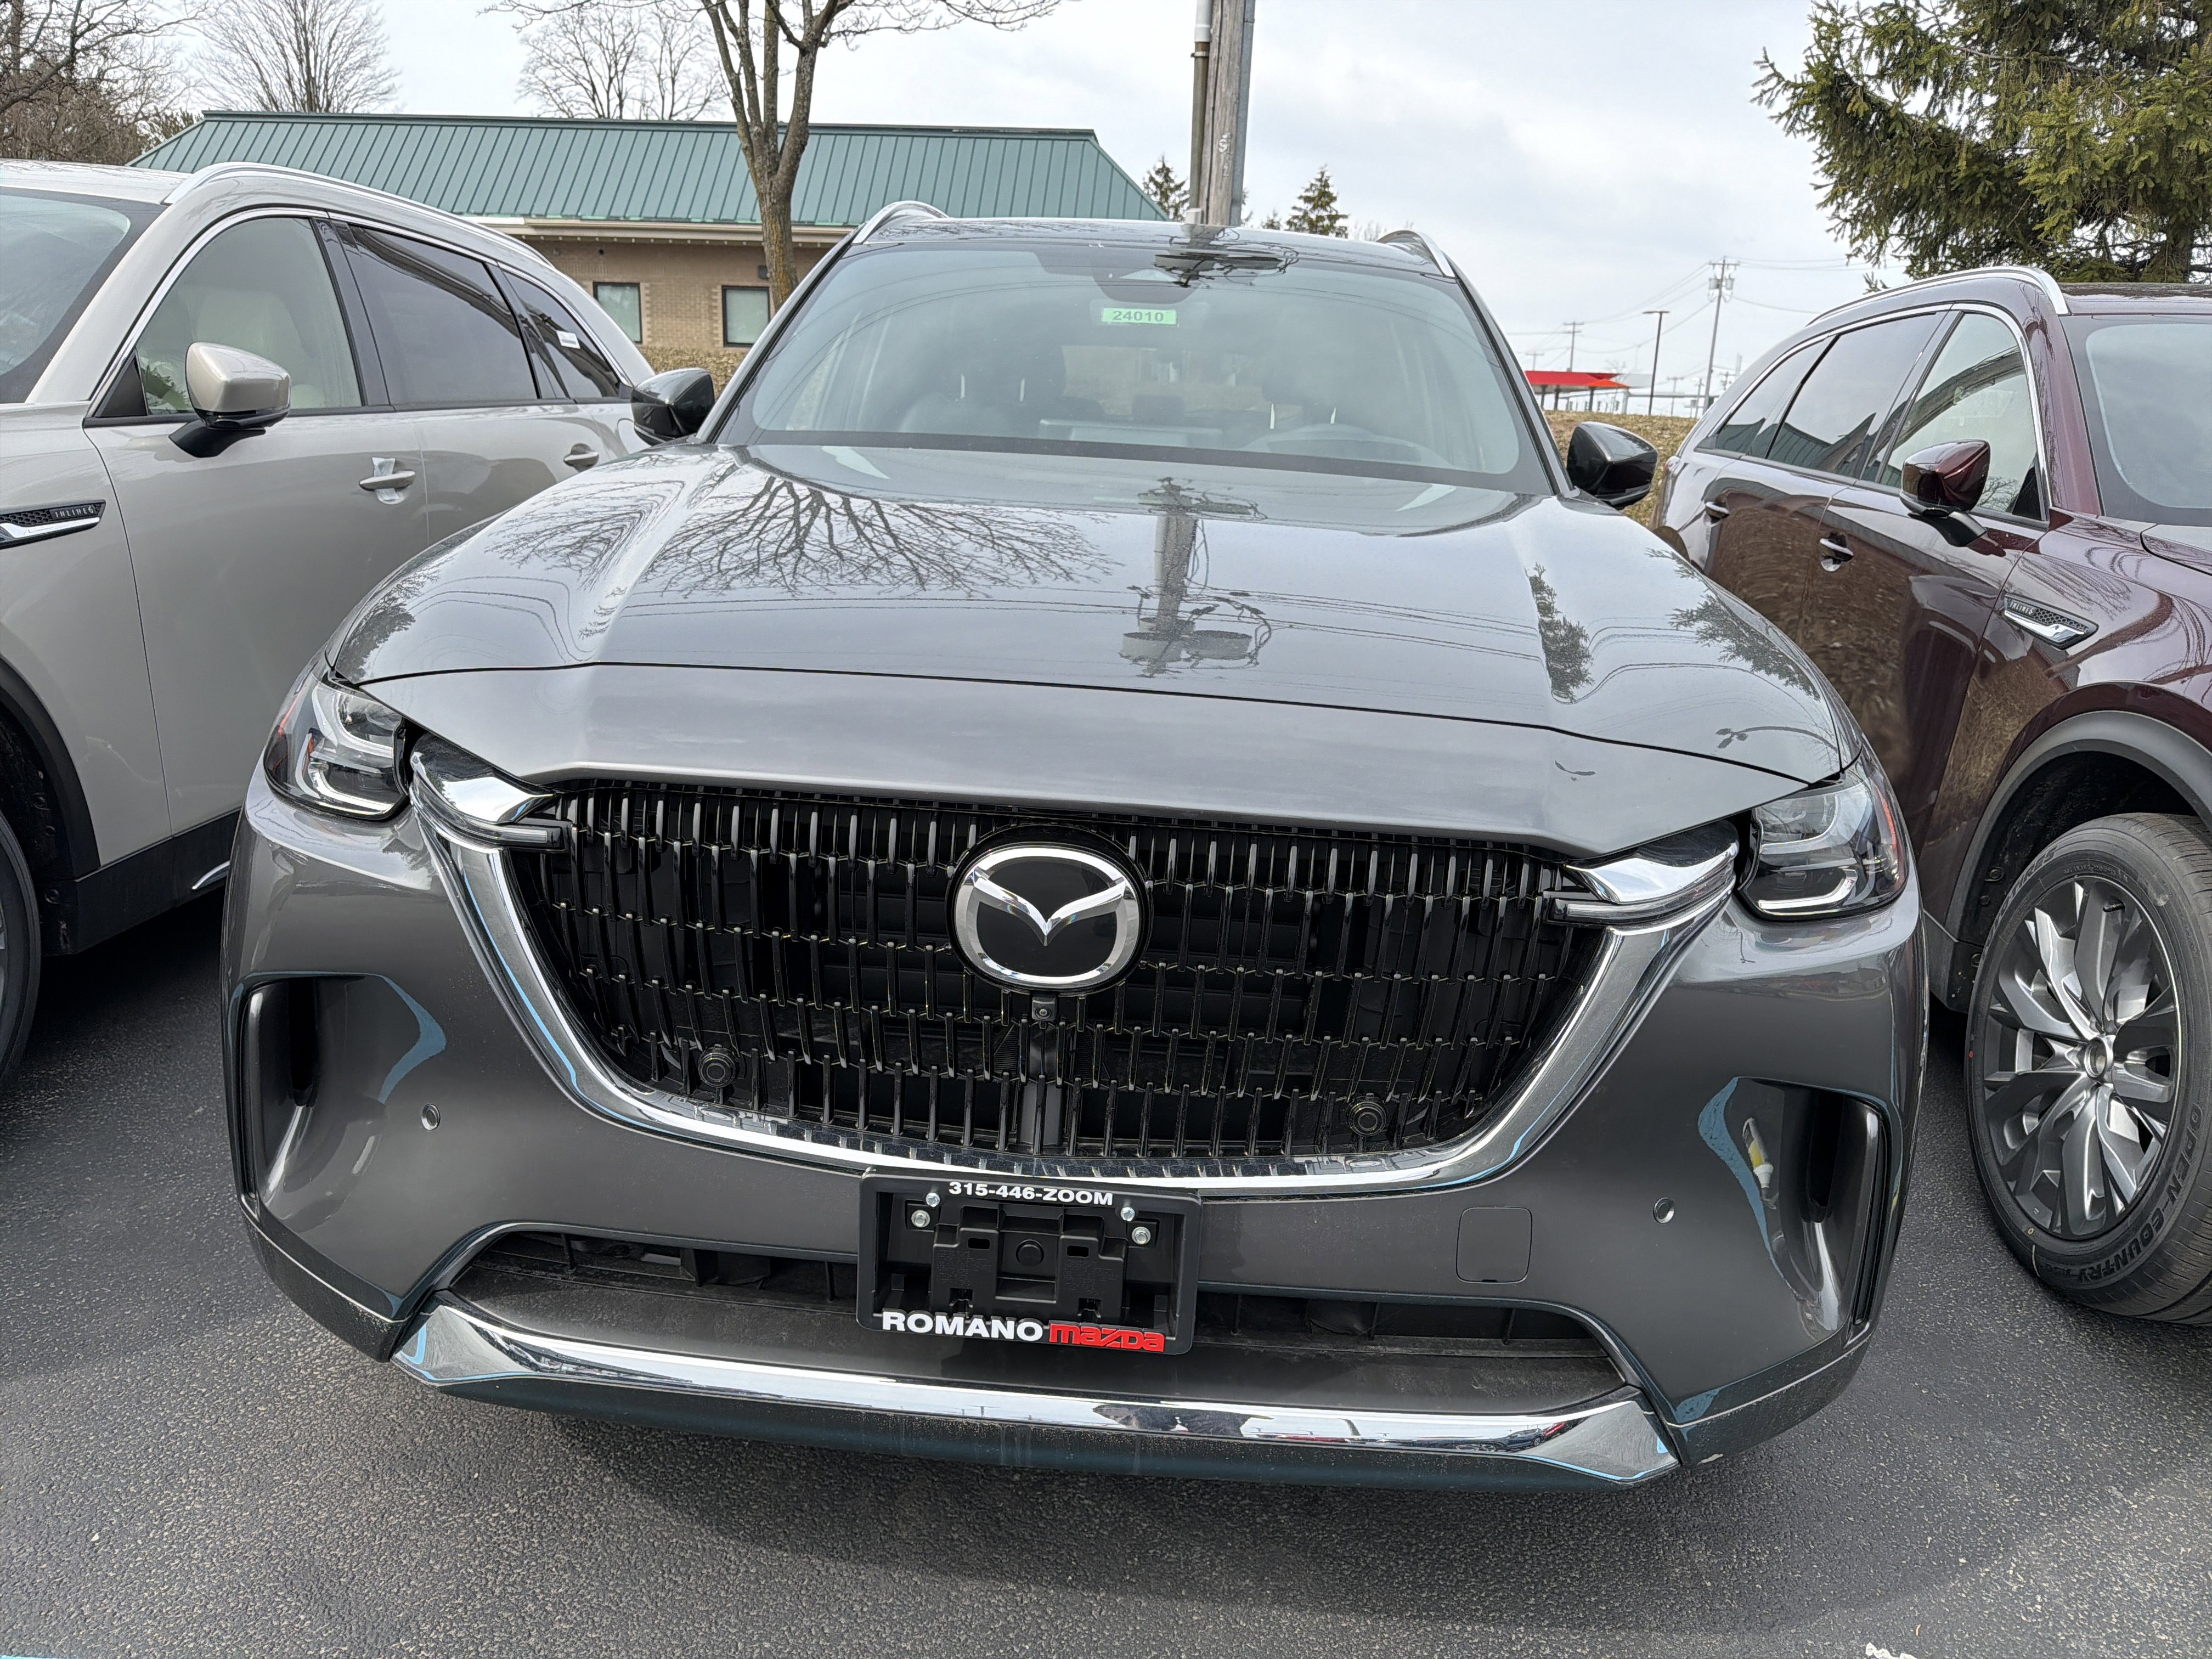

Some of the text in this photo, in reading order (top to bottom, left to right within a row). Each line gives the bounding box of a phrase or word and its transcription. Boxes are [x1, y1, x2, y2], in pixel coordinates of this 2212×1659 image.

[1113, 311, 1164, 322] 24010
[55, 505, 94, 518] INLINE 6
[949, 1181, 1113, 1206] 315-446-ZOOM
[882, 1311, 1043, 1341] ROMANO
